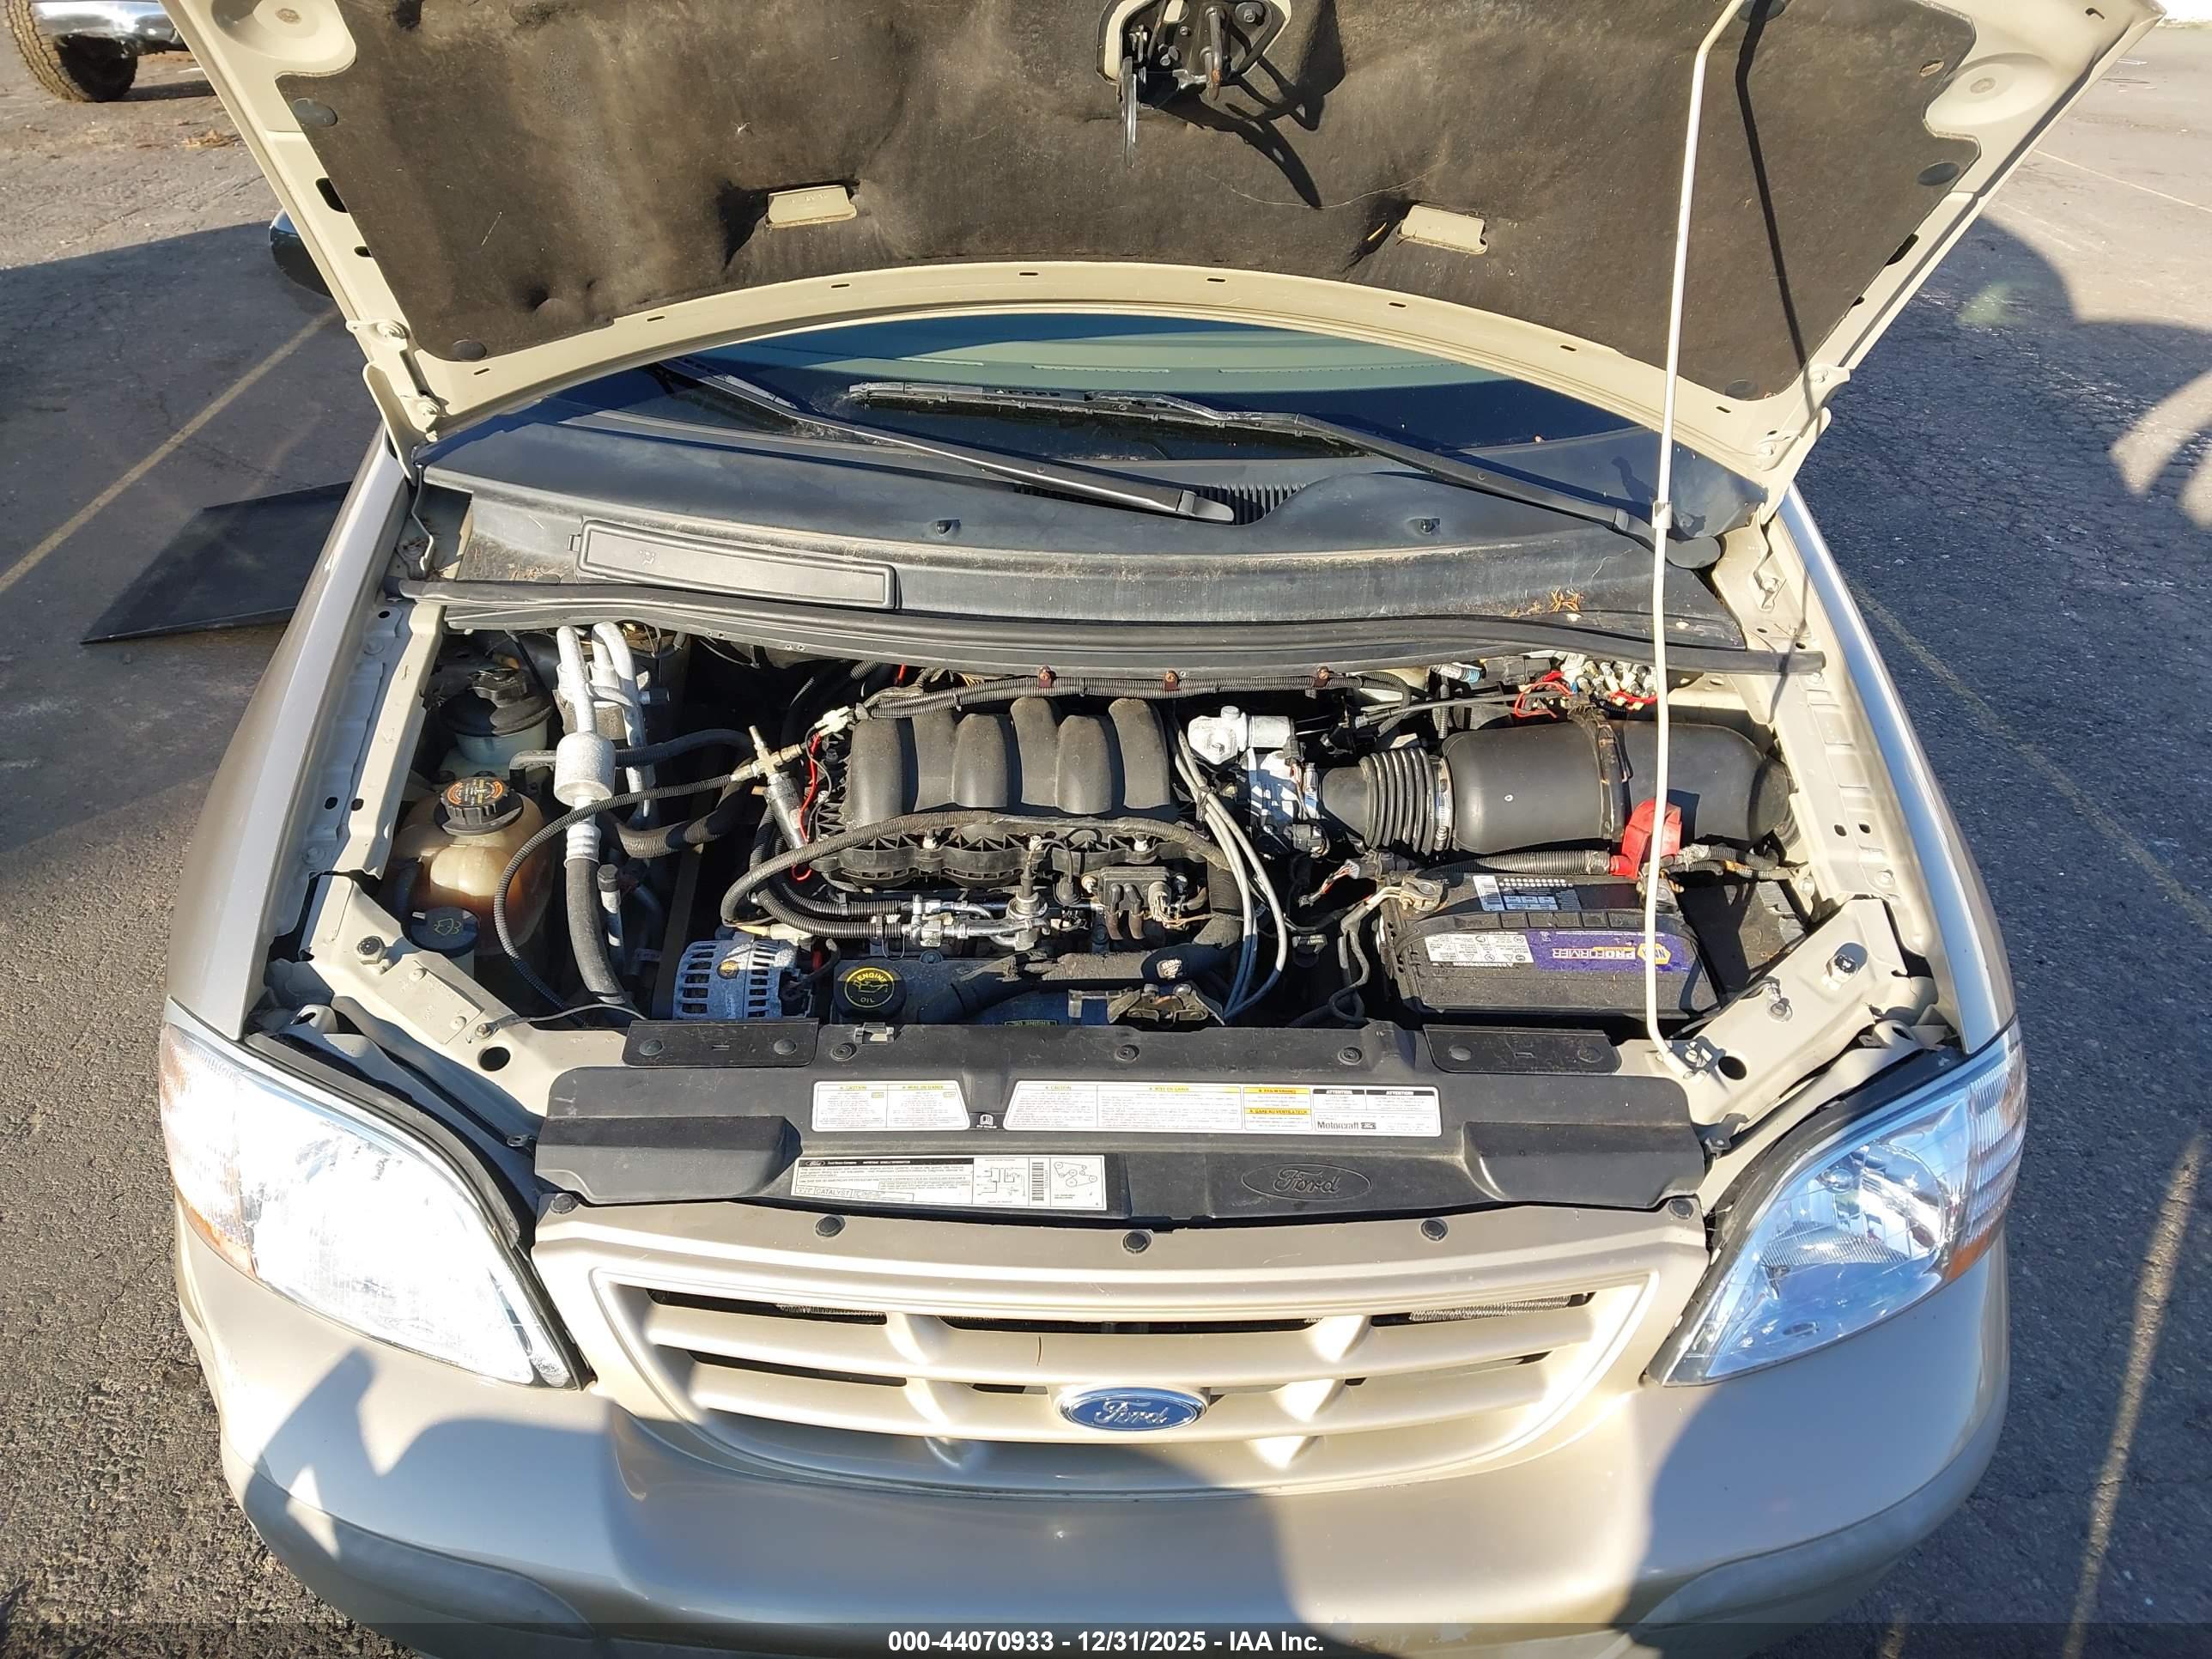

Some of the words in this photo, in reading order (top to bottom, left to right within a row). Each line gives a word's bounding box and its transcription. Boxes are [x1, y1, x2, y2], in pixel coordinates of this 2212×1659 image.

[1553, 948, 1635, 959] PROFORMER
[857, 972, 887, 984] ENGINE
[1317, 1121, 1358, 1130] Motorcraft
[1273, 1168, 1340, 1194] Ford
[816, 1188, 850, 1197] CATALYST
[1093, 1397, 1169, 1424] Ford
